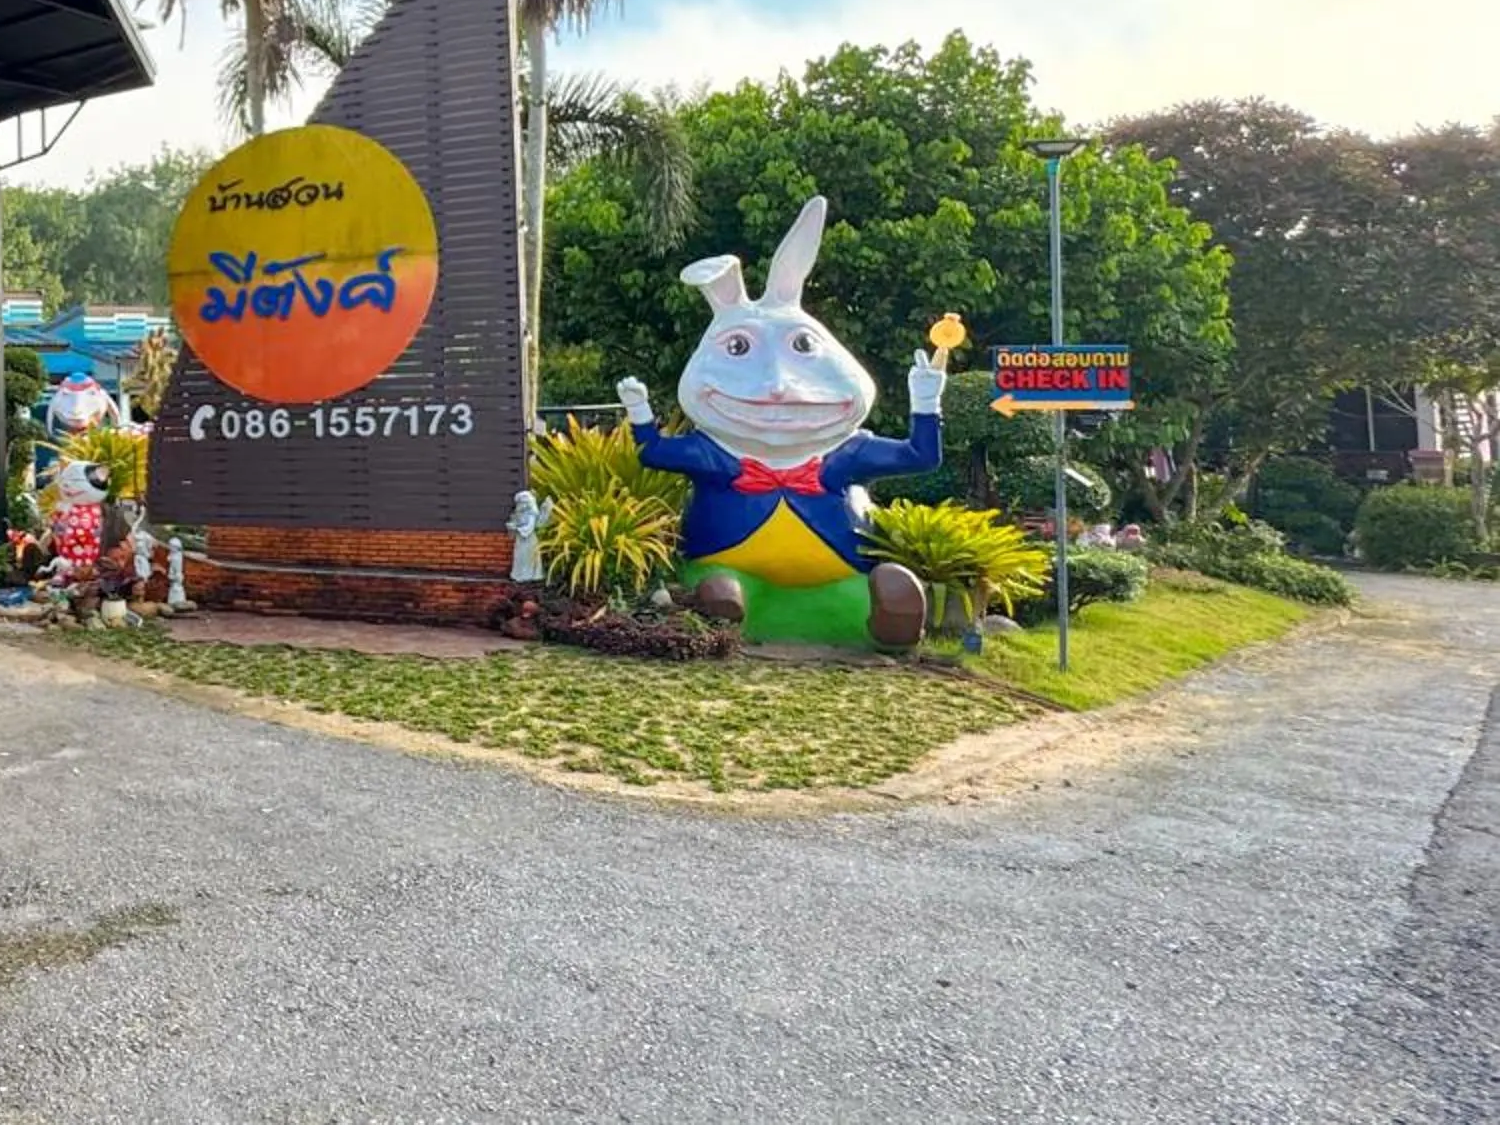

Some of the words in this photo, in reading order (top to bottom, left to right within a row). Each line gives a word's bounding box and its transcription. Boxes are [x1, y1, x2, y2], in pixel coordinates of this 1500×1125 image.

[208, 177, 344, 213] บ้านสวน
[199, 247, 406, 323] มีตังค์
[997, 345, 1129, 368] ติดต่อสอบถาม
[996, 369, 1092, 390] CHECK
[1098, 369, 1128, 390] IN
[220, 403, 474, 439] 086-1557173
